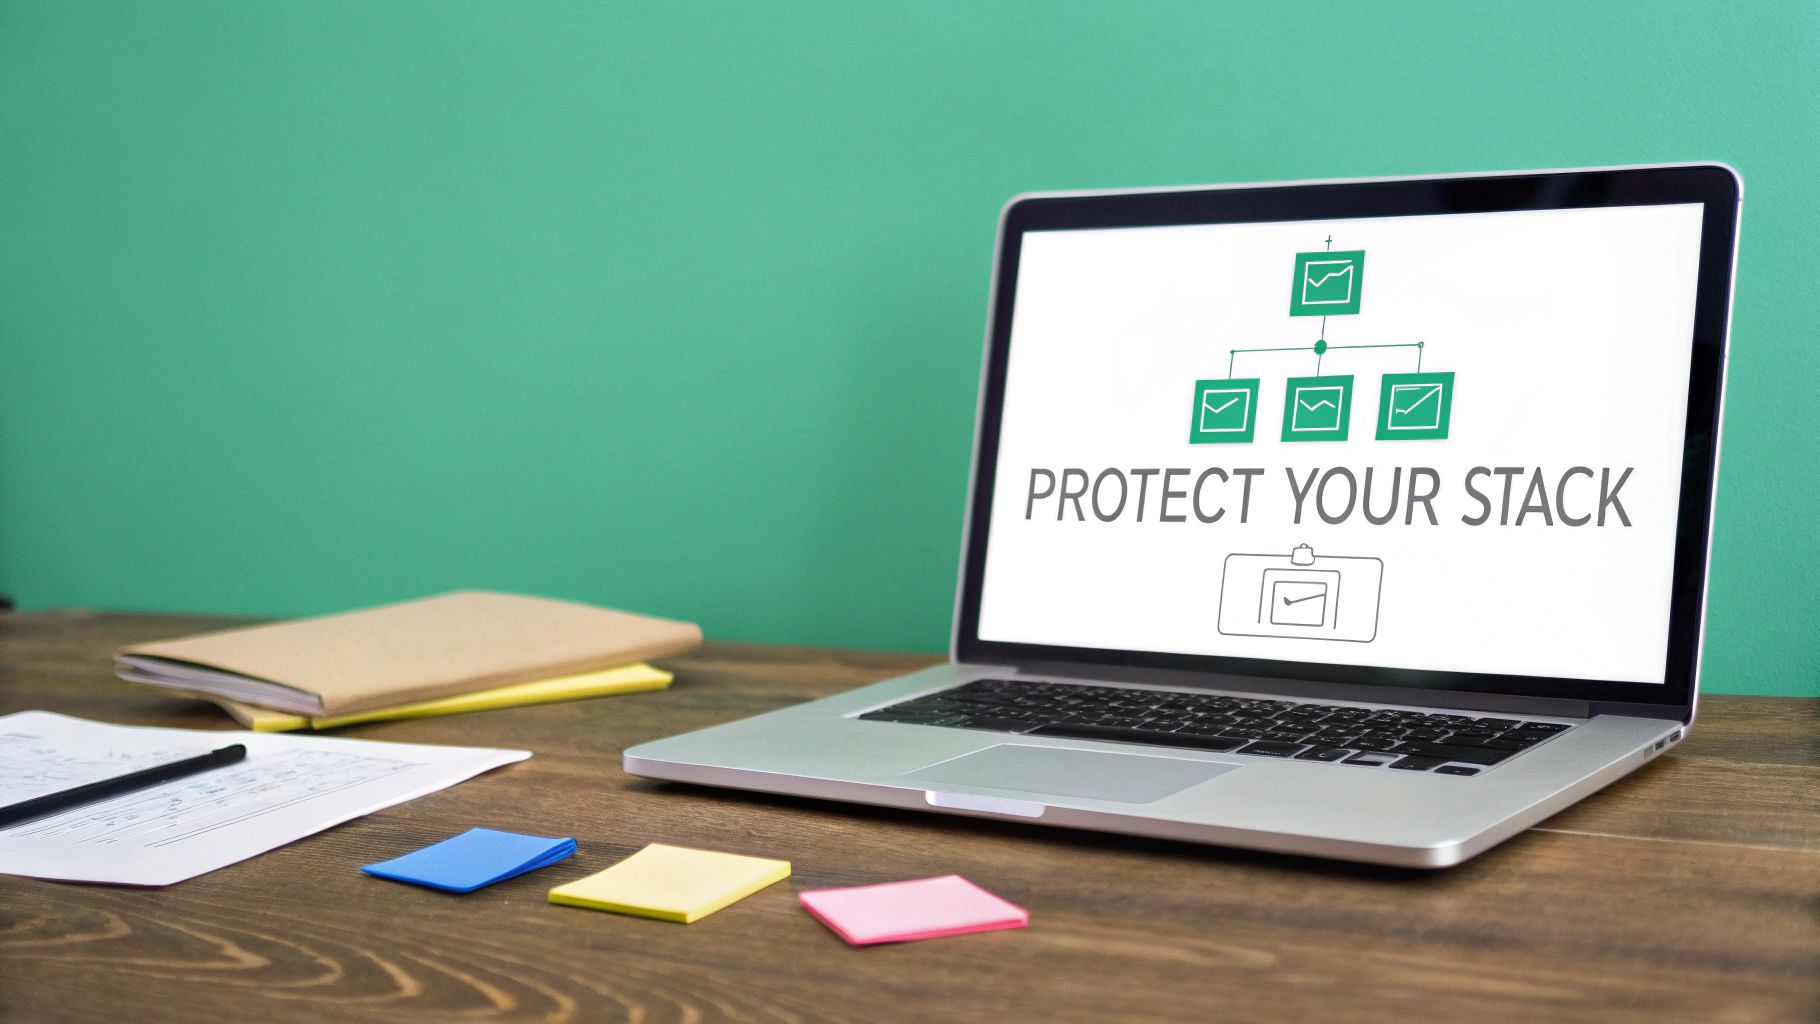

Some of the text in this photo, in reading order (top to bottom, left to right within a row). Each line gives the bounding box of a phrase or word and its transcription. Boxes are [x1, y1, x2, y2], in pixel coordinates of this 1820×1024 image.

[1025, 466, 1634, 527] PROTECT YOUR STACK
